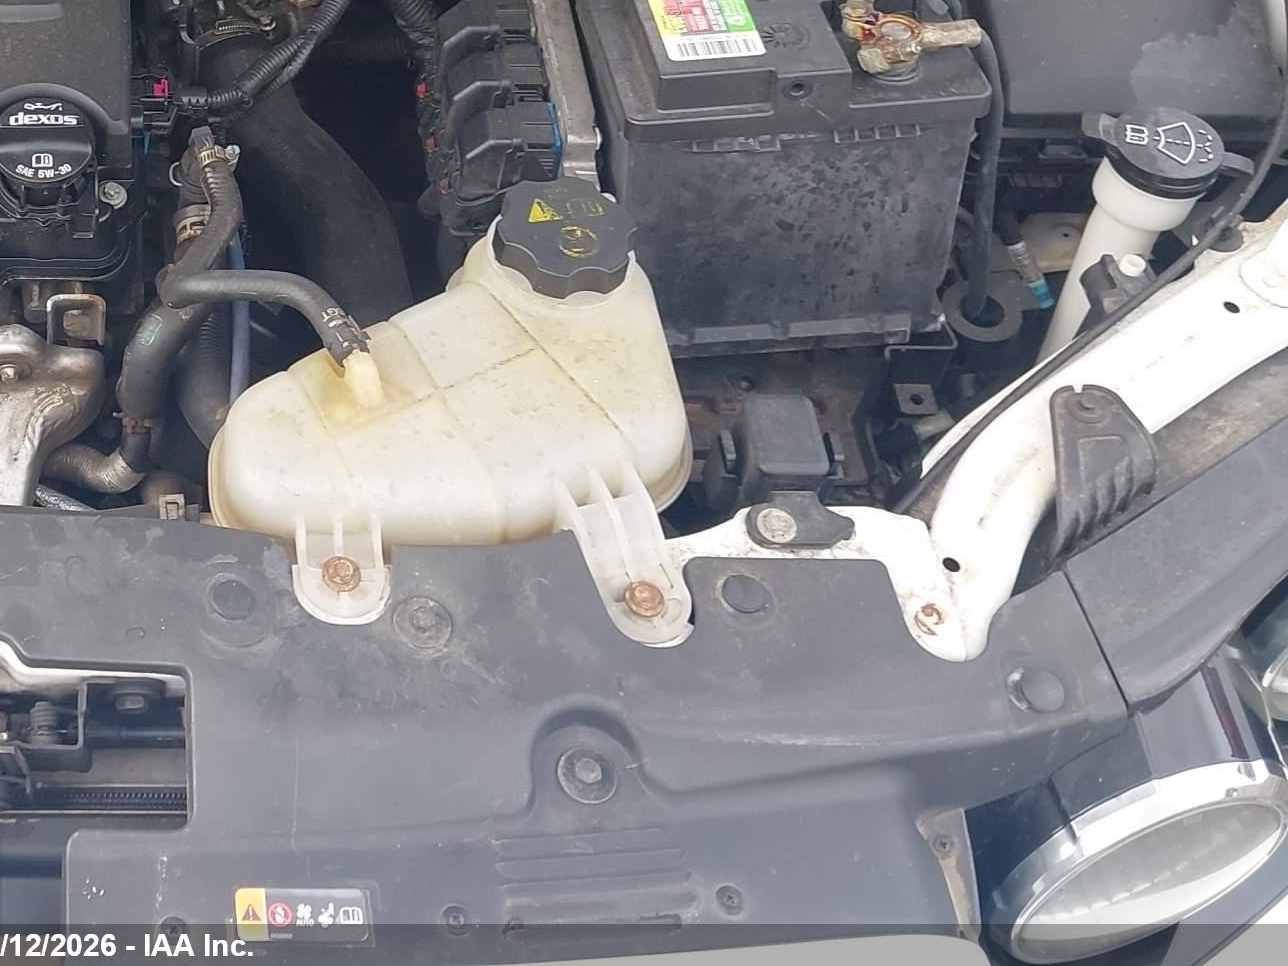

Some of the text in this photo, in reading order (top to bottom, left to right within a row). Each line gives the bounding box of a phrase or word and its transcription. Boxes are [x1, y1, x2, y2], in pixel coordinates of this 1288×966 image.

[9, 112, 80, 126] dexos
[15, 164, 72, 178] SAE 5W-30
